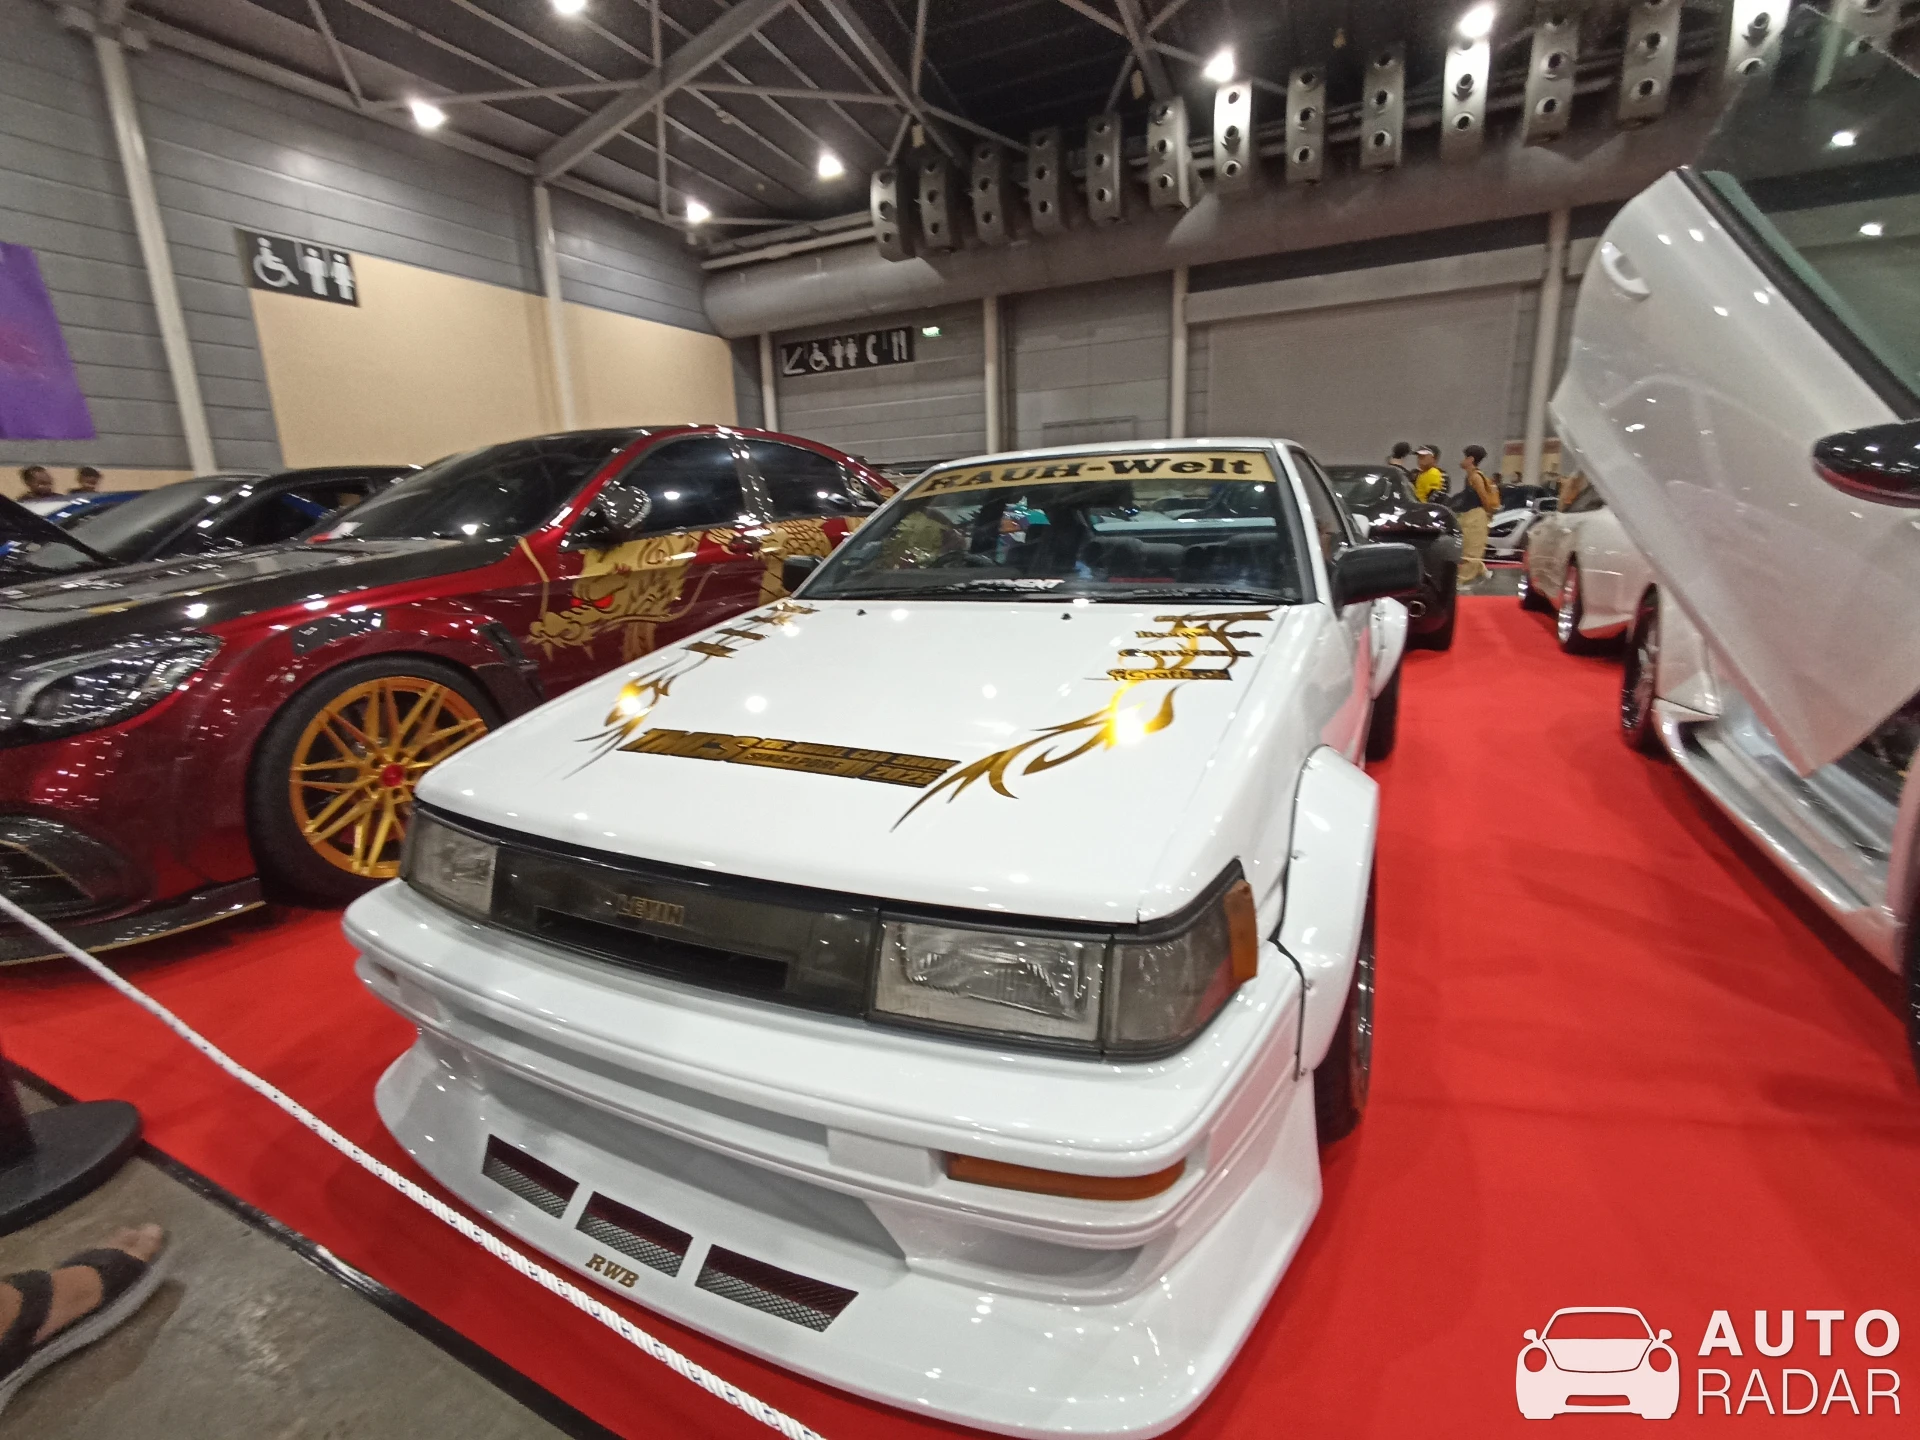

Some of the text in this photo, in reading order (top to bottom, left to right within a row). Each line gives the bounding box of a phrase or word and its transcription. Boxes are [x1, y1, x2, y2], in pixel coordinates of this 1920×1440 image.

[922, 457, 1253, 493] RAUH-Welt
[865, 766, 939, 784] 2025
[617, 894, 684, 926] LEVIN
[585, 1253, 639, 1288] RWB
